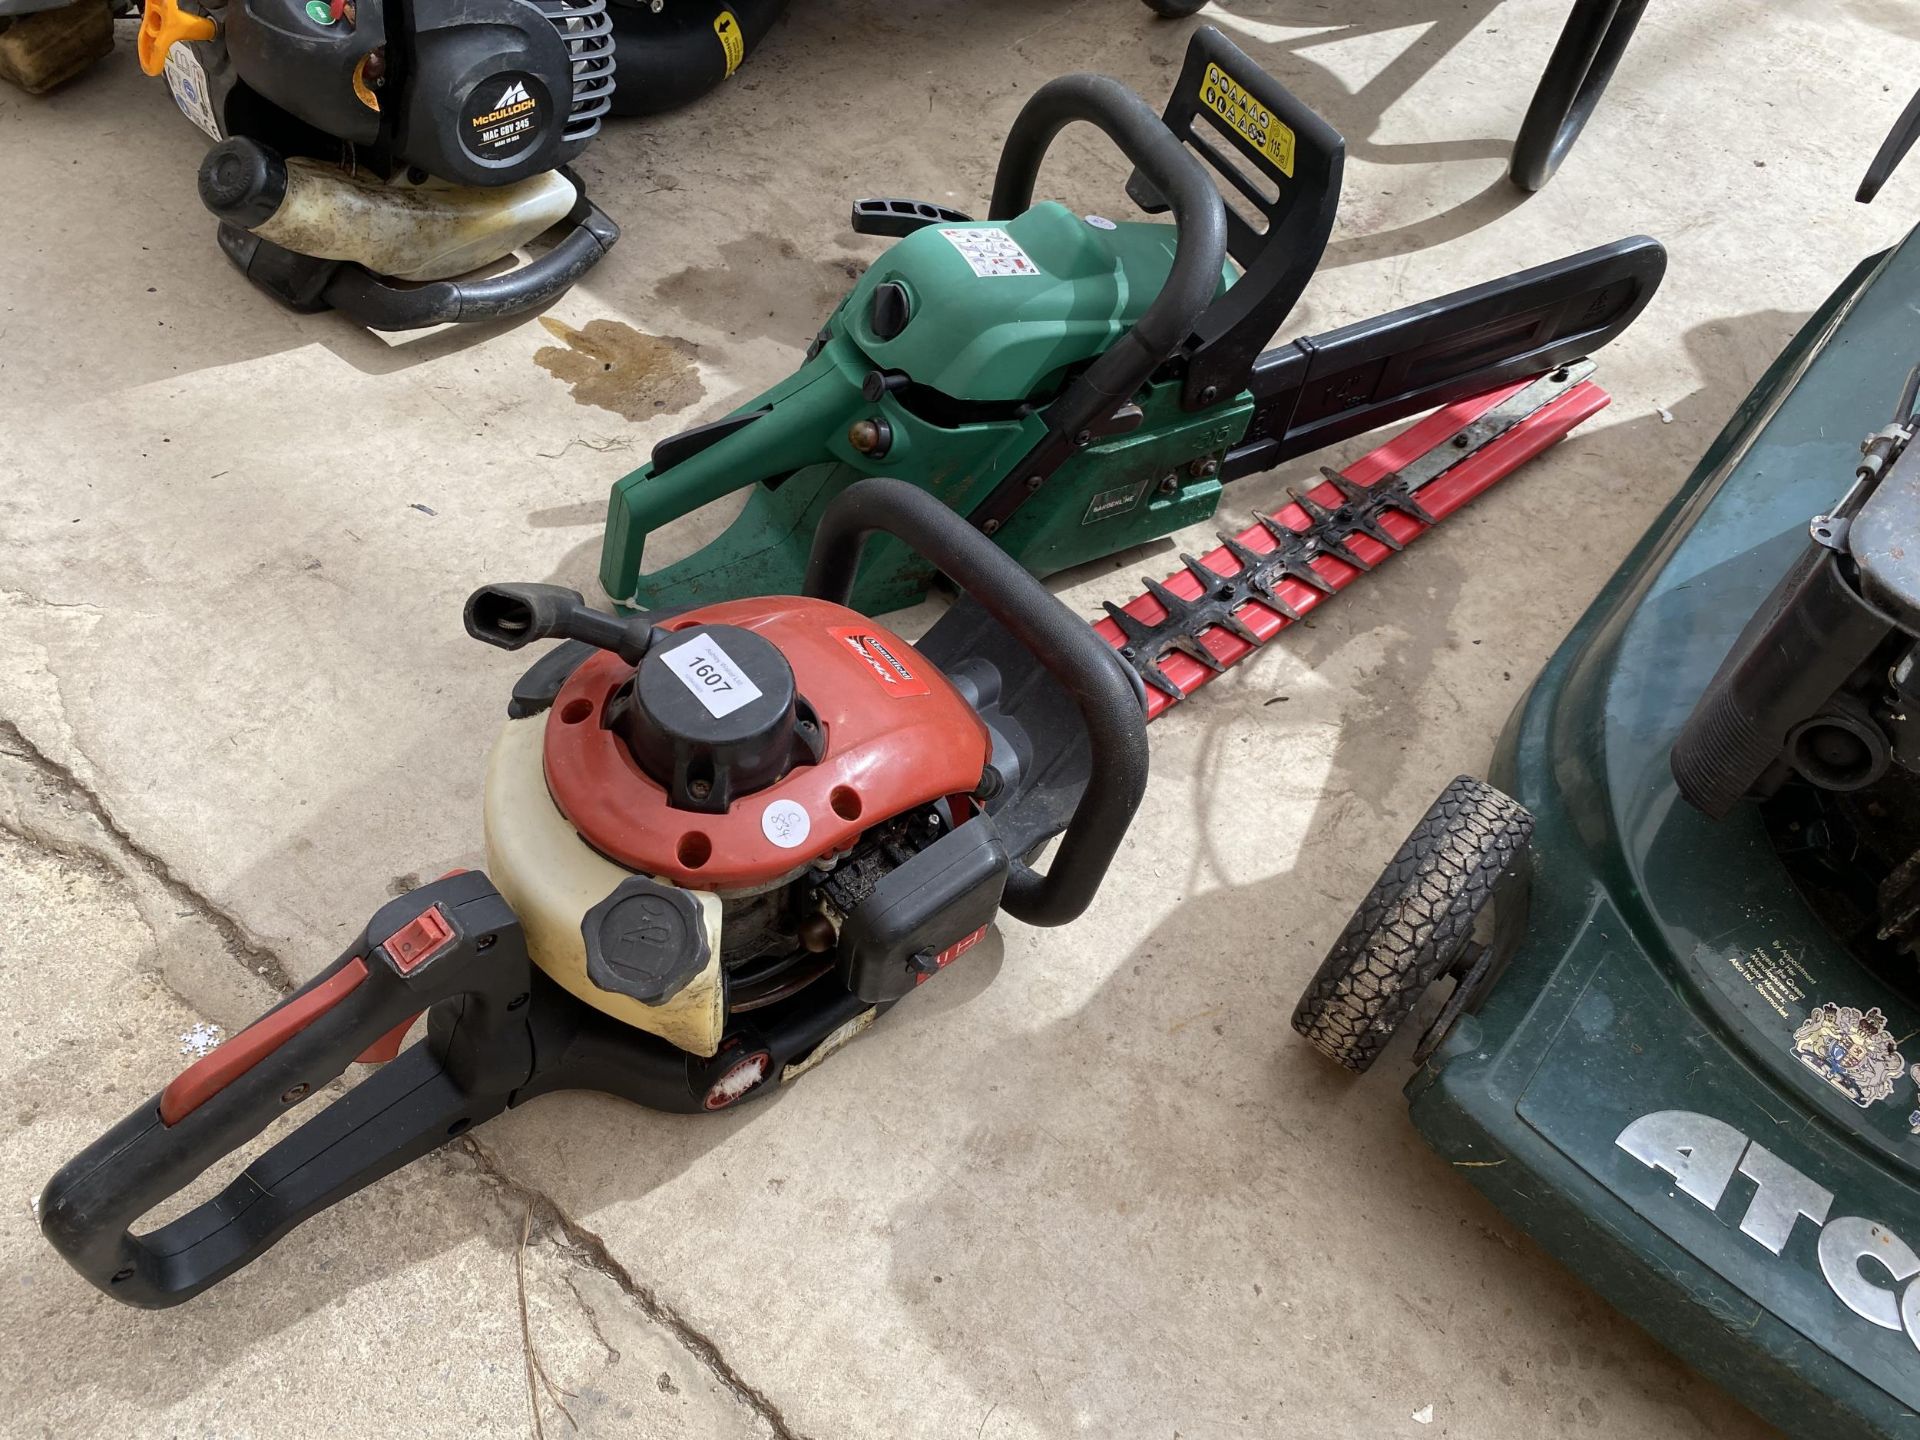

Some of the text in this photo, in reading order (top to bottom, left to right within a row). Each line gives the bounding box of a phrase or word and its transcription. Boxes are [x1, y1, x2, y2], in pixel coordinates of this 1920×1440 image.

[472, 98, 536, 127] McCULLOCH
[482, 129, 499, 142] MAC
[515, 118, 530, 131] 345
[688, 656, 733, 693] 1607
[1745, 961, 1764, 979] Motor
[1750, 954, 1800, 1001] Manufacturers of
[1754, 947, 1806, 999] Majesty the Queen
[1772, 940, 1817, 985] By Appointment
[1785, 964, 1797, 976] Her
[1615, 1110, 1920, 1352] ATC
